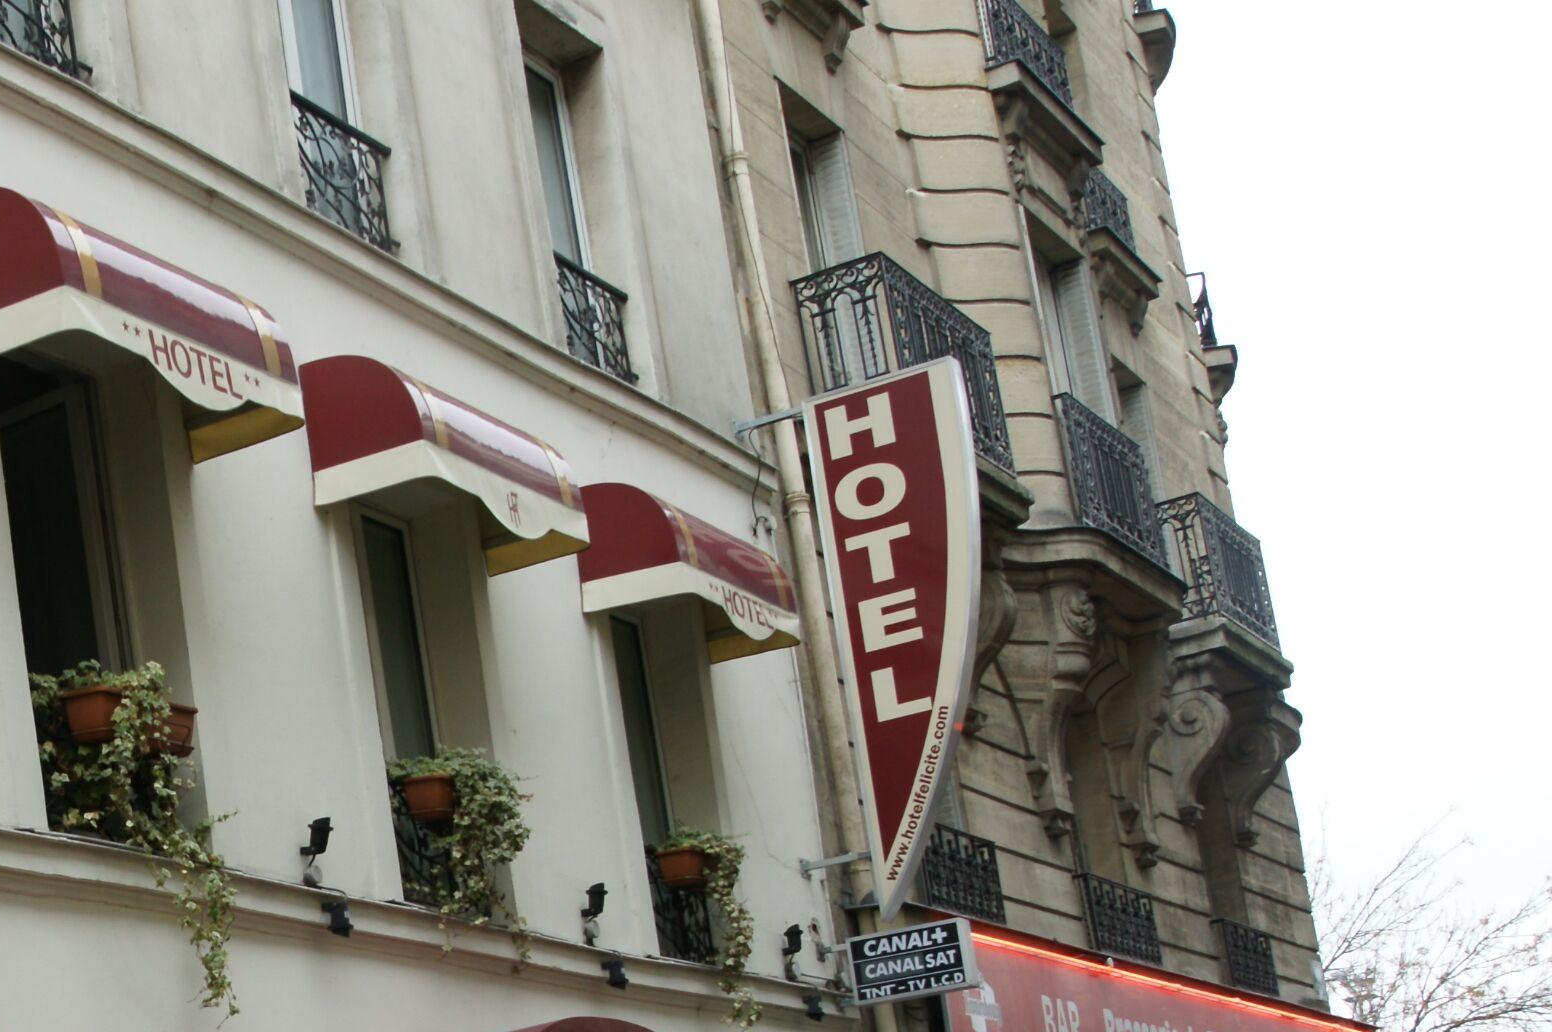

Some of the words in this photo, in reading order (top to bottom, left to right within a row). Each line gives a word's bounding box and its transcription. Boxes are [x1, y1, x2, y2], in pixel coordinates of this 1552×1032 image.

[148, 328, 244, 400] HOTEL
[823, 391, 933, 724] HOTEL
[721, 586, 775, 630] HOTEL
[885, 704, 950, 882] www.hotelfelicite.com
[863, 926, 948, 957] CANAL+
[861, 983, 896, 1000] TNT
[907, 978, 927, 992] TV
